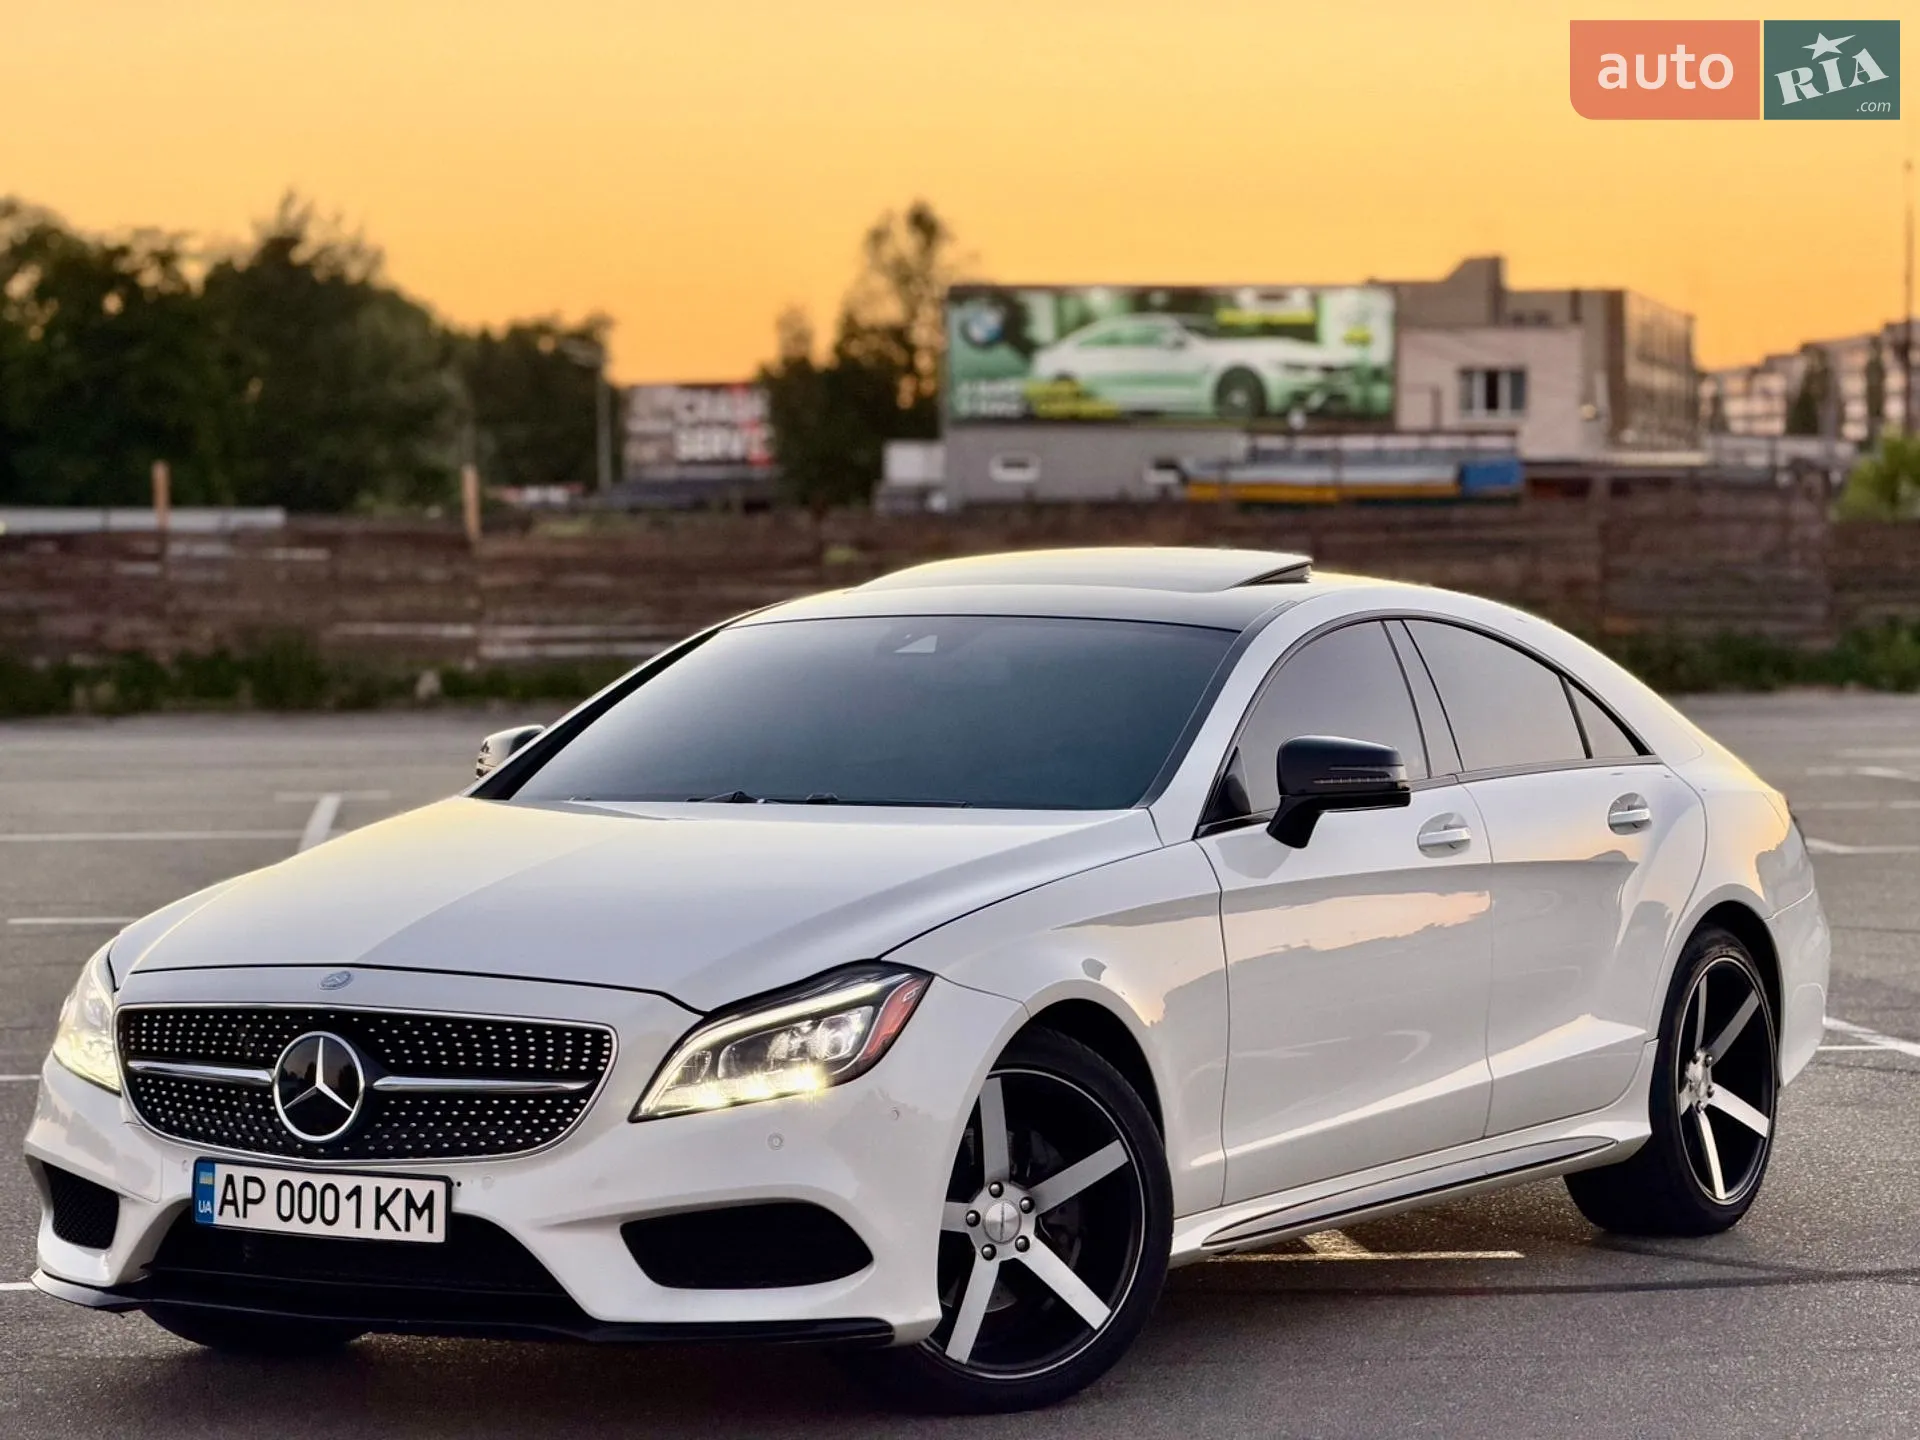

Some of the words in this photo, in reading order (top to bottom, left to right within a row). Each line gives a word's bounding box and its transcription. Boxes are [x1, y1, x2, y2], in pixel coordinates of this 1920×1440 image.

[198, 1200, 213, 1215] UA
[218, 1173, 266, 1219] AP
[276, 1179, 362, 1230] 0001
[375, 1185, 434, 1234] KM
